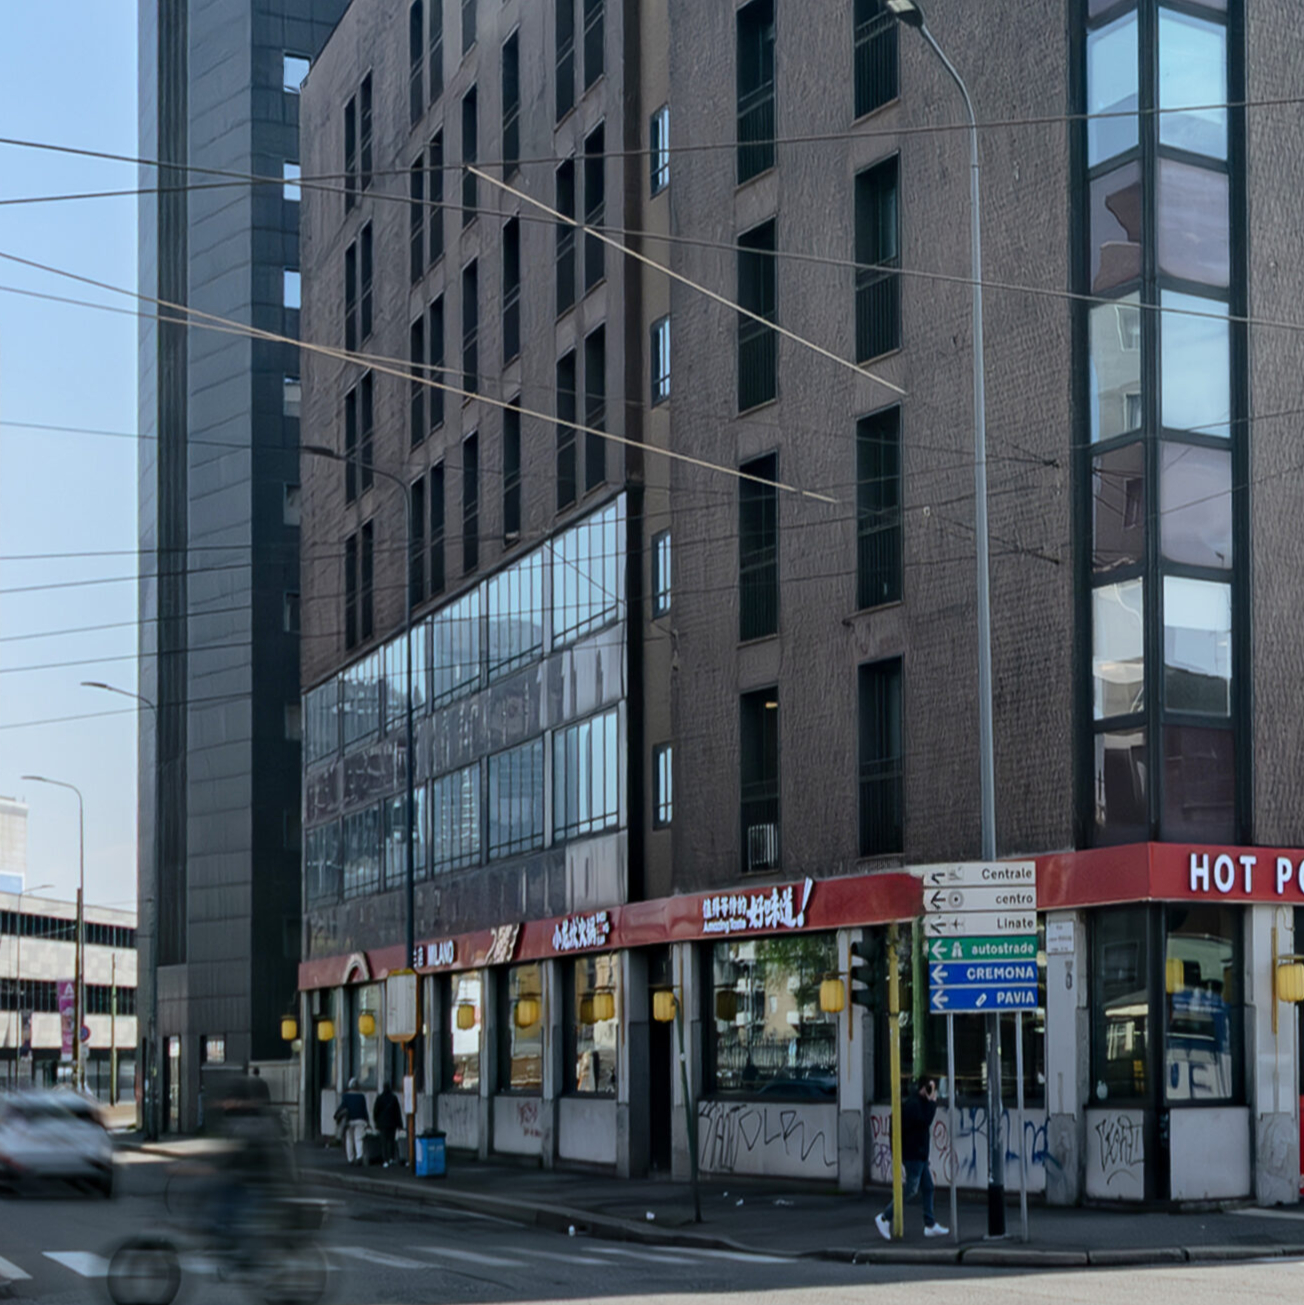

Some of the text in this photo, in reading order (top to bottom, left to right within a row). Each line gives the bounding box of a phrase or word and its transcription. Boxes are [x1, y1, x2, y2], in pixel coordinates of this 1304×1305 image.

[981, 868, 1033, 880] Centrale
[1190, 853, 1256, 893] HOT
[995, 893, 1034, 904] centro
[997, 918, 1034, 929] Linate
[971, 942, 1034, 955] autostrade
[966, 966, 1034, 980] CREMONA
[996, 990, 1035, 1004] PAVIA
